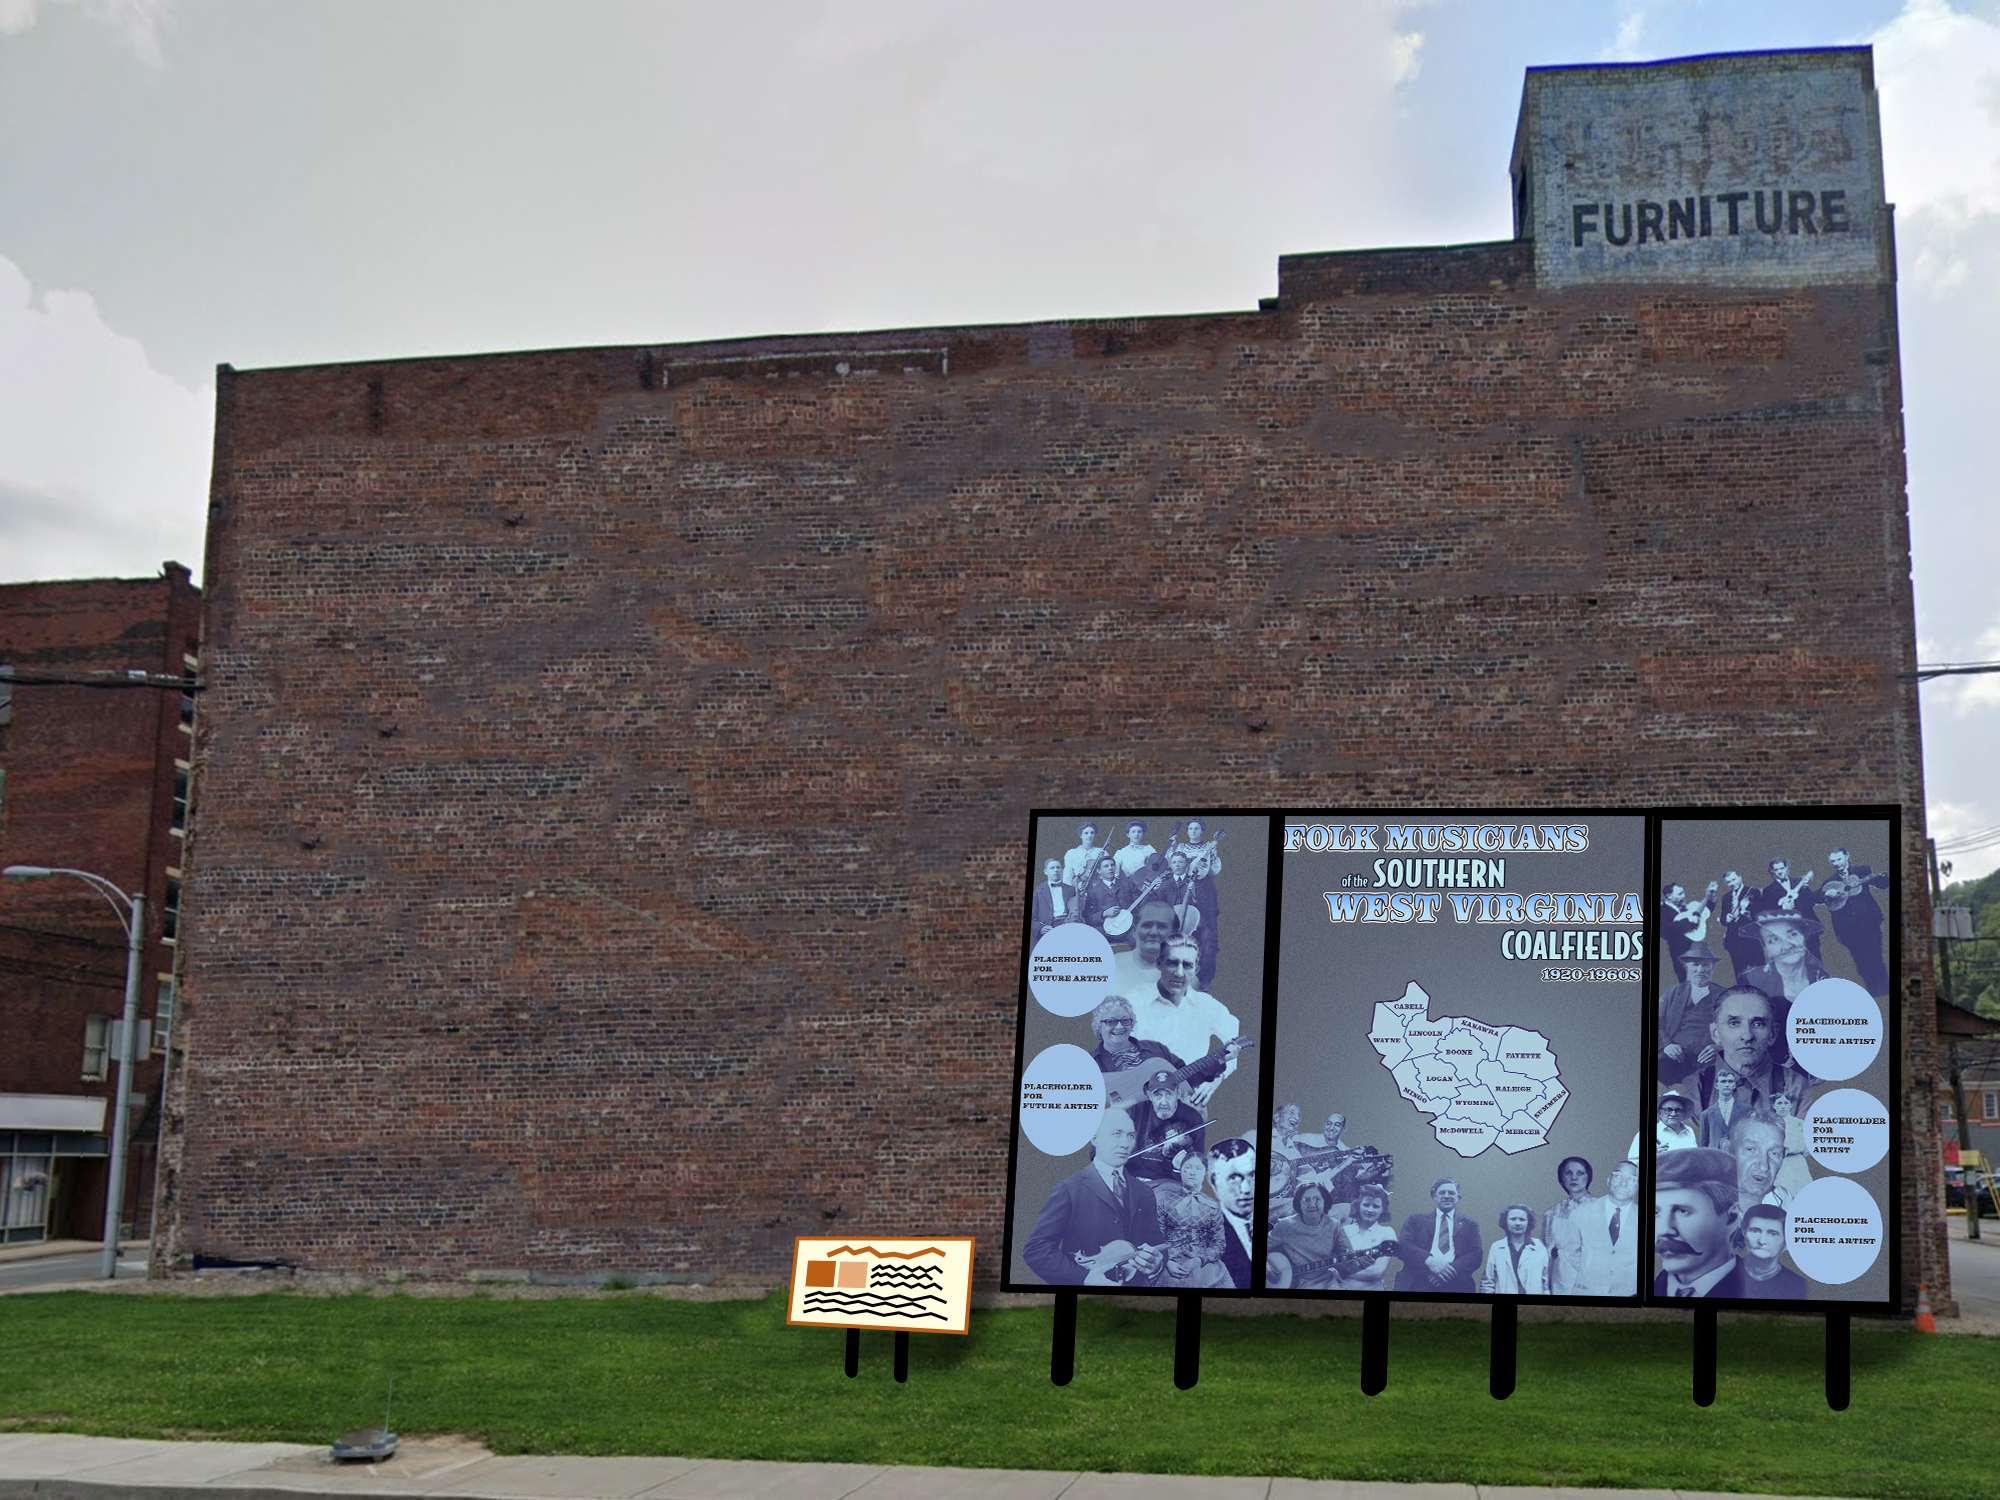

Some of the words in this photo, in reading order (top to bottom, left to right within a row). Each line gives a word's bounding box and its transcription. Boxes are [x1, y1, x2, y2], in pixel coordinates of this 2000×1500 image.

[1573, 189, 1849, 247] FURNITURE
[1284, 825, 1379, 852] FOLK
[1384, 825, 1588, 853] MUSICIANS
[1341, 874, 1353, 888] of
[1353, 874, 1368, 888] the
[1372, 857, 1506, 889] SOUTHERN
[1323, 892, 1441, 923] WEST
[1447, 893, 1644, 924] VIRGINIA
[1501, 929, 1643, 961] COALFIELDS
[1795, 1018, 1869, 1026] PLACEHOLDER
[1023, 1083, 1093, 1091] PLACEHOLDER
[1495, 1085, 1532, 1093] RALEIGH
[1402, 1087, 1428, 1104] MINGO
[1534, 1089, 1567, 1119] SUMMERS
[1812, 1116, 1887, 1125] PLACEHOLDER
[1505, 1128, 1541, 1136] MERCER
[1812, 1126, 1834, 1134] FOR
[1812, 1136, 1855, 1145] FUTURE
[1812, 1146, 1851, 1154] ARTIST
[1794, 1217, 1868, 1225] PLACEHOLDER
[1794, 1236, 1836, 1244] FUTURE
[1837, 1237, 1876, 1245] ARTIST
